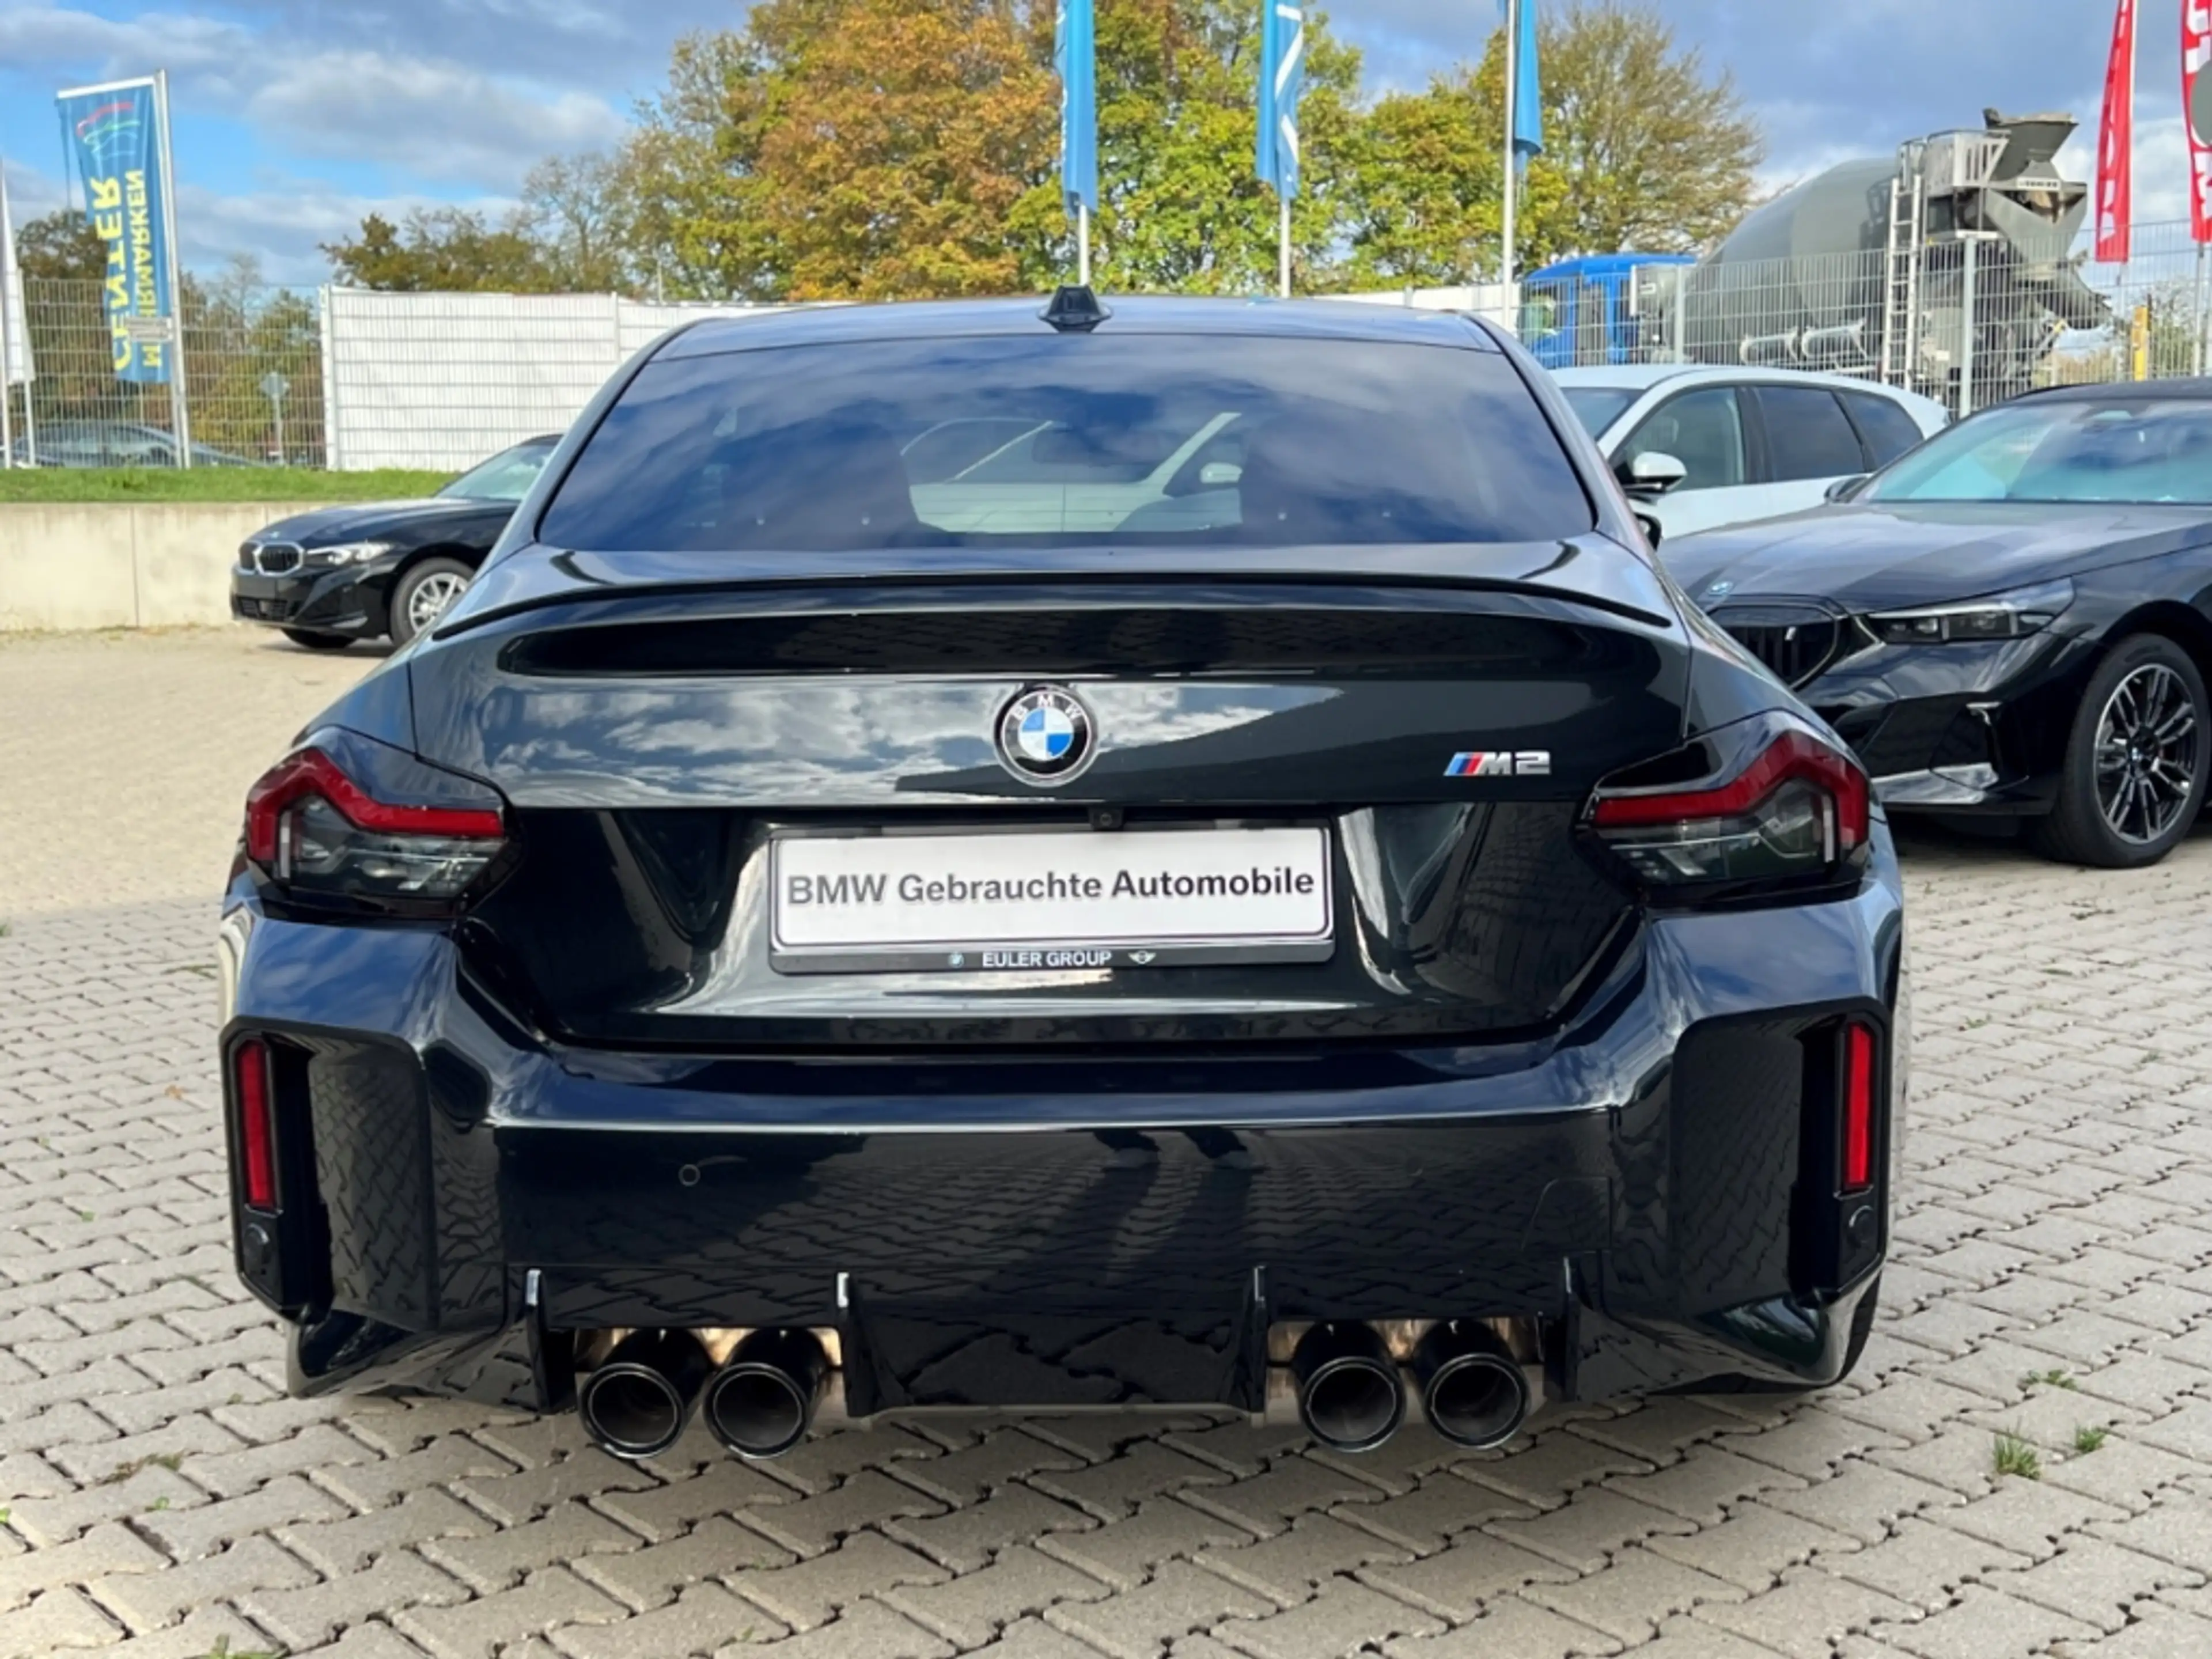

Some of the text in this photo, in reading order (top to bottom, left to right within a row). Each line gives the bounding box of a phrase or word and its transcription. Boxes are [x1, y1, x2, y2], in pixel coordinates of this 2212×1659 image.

[1010, 693, 1084, 721] BMW
[1472, 750, 1551, 776] M2
[787, 866, 1315, 905] BMW Gebrauchte Automobile
[982, 950, 1112, 968] EULER GROUP
